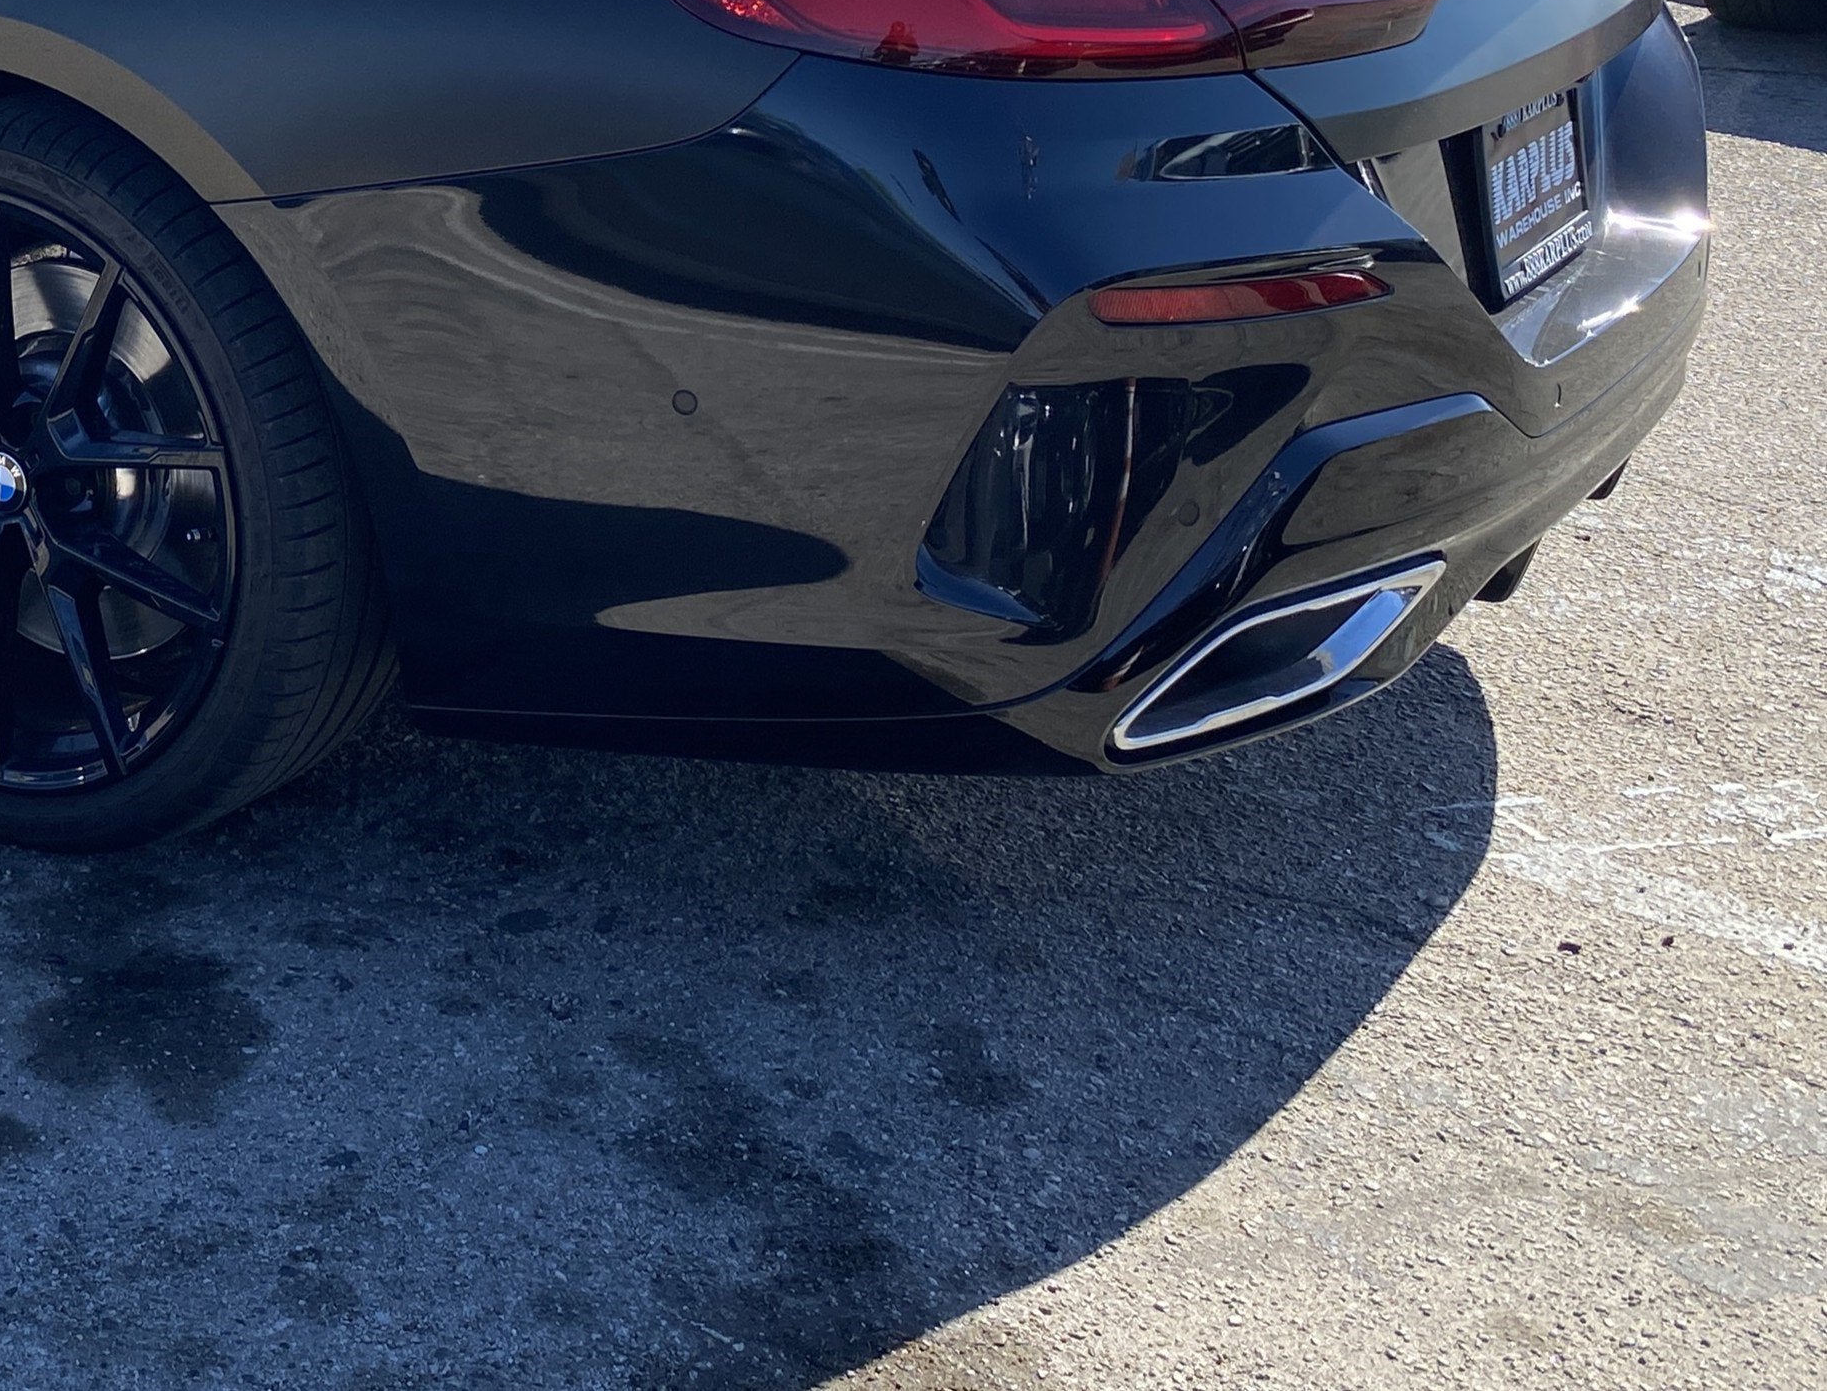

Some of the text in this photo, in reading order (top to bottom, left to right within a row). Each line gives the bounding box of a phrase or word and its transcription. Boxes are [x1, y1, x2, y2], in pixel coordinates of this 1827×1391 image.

[1491, 121, 1575, 225] KARPLUS
[1496, 181, 1581, 249] WAREHOUSE INC
